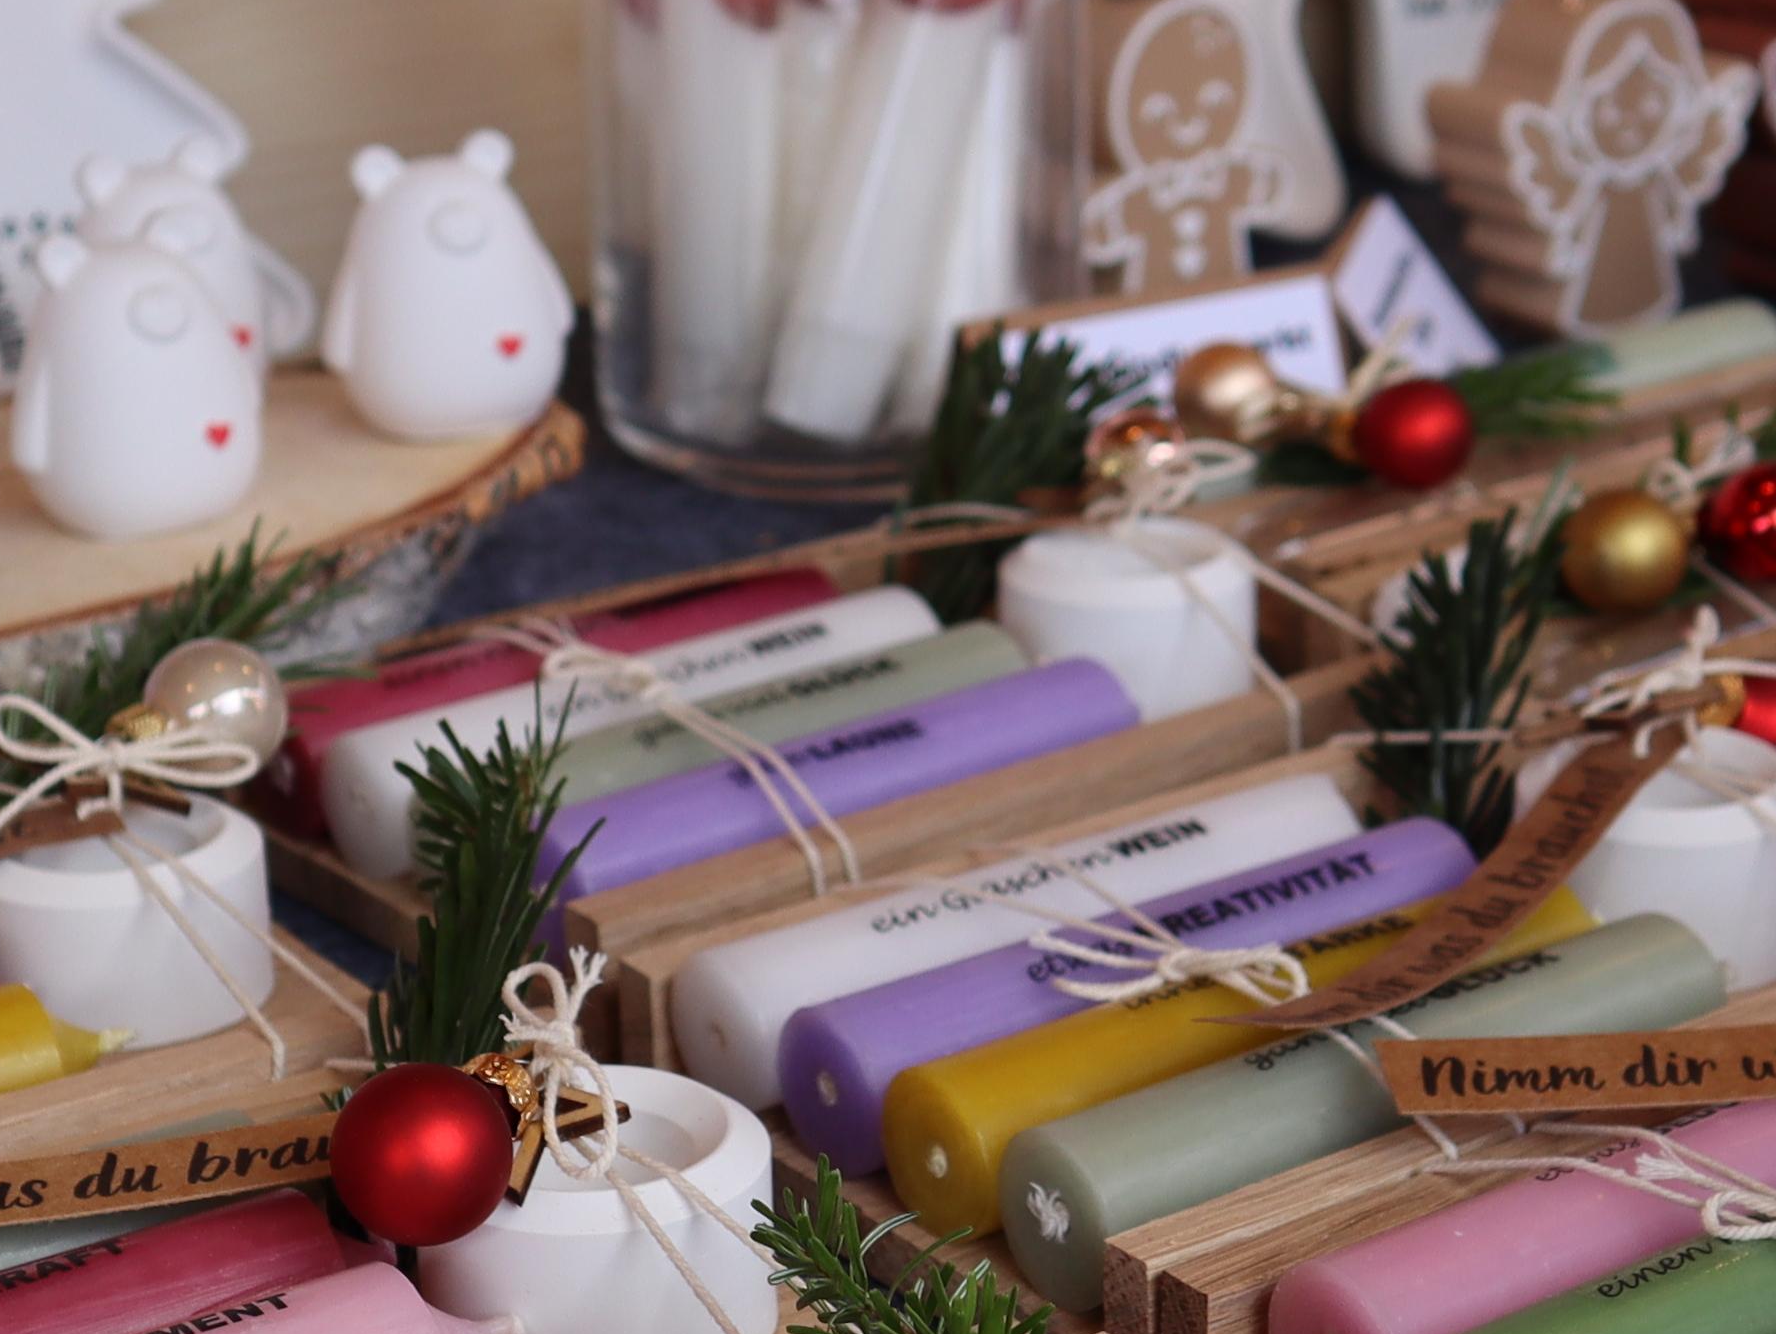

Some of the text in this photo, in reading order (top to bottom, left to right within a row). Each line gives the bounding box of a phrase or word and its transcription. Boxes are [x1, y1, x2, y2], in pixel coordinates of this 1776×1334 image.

[1108, 816, 1208, 857] WEIN
[1421, 1055, 1606, 1098] Nimm
[1622, 1044, 1718, 1089] dir
[73, 1152, 162, 1201] du
